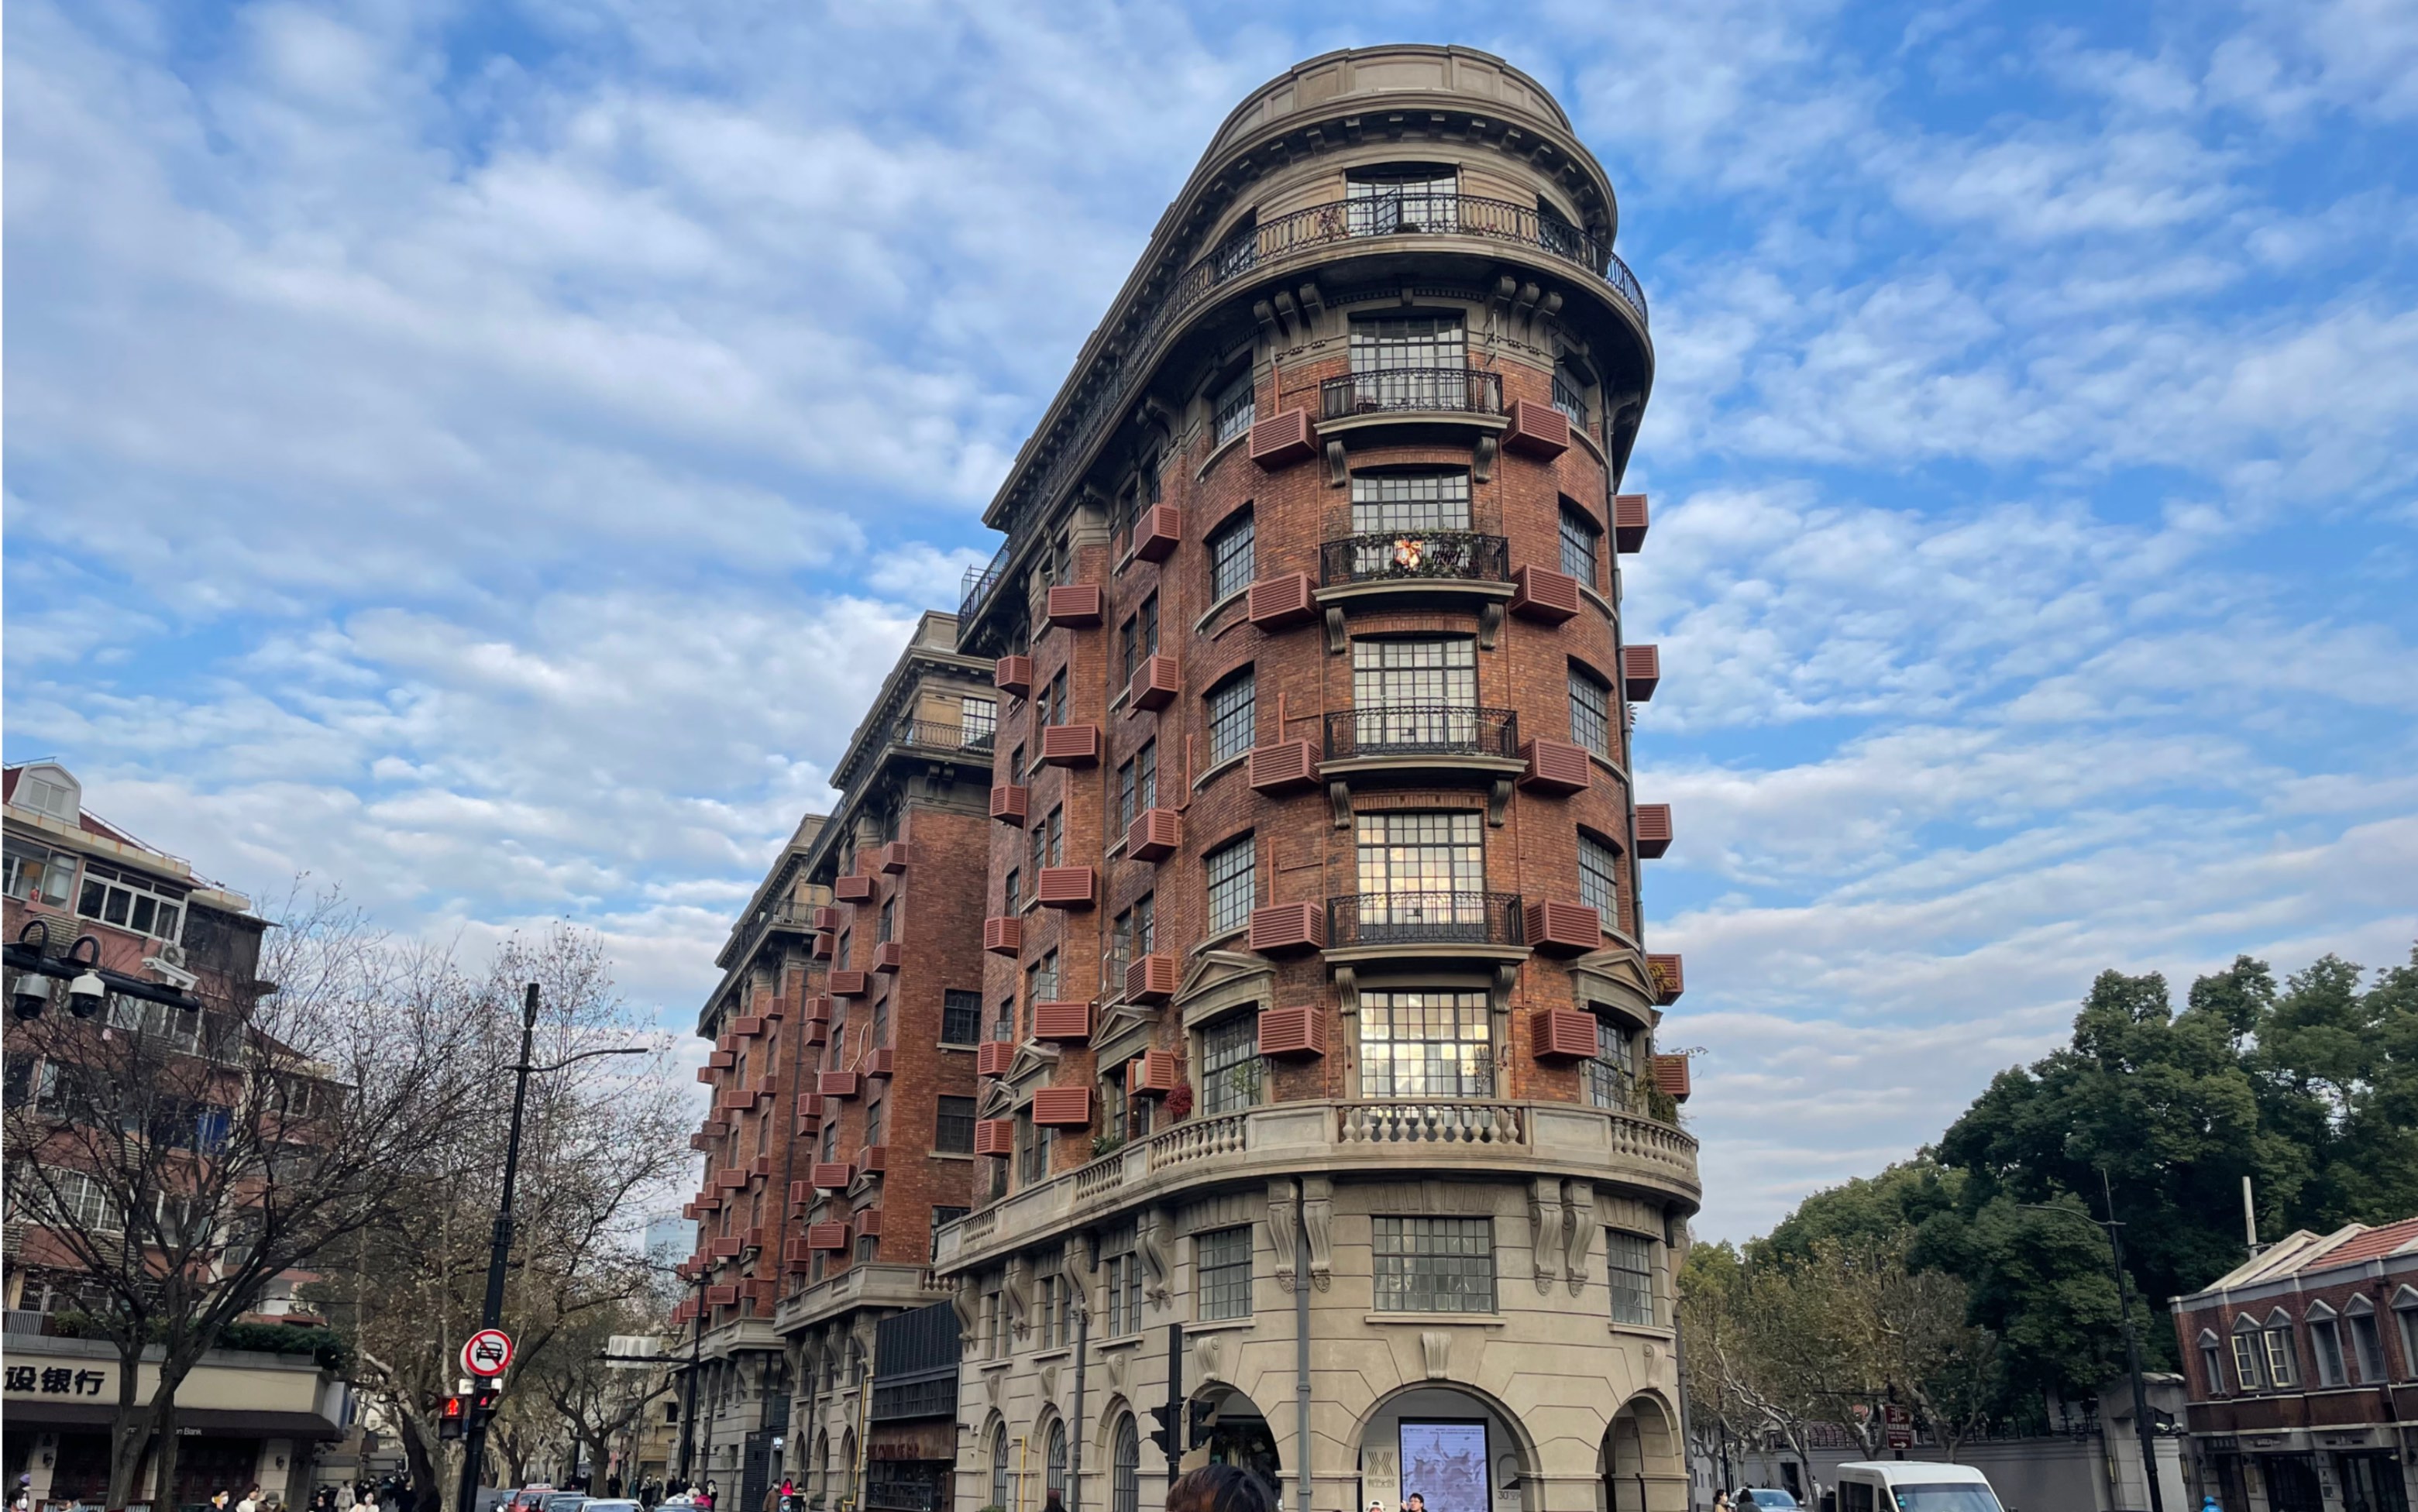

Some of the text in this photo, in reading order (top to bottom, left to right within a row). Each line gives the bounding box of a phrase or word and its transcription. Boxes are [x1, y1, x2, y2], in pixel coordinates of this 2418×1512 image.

[5, 1366, 105, 1396] 设银行
[184, 1427, 202, 1435] Bank
